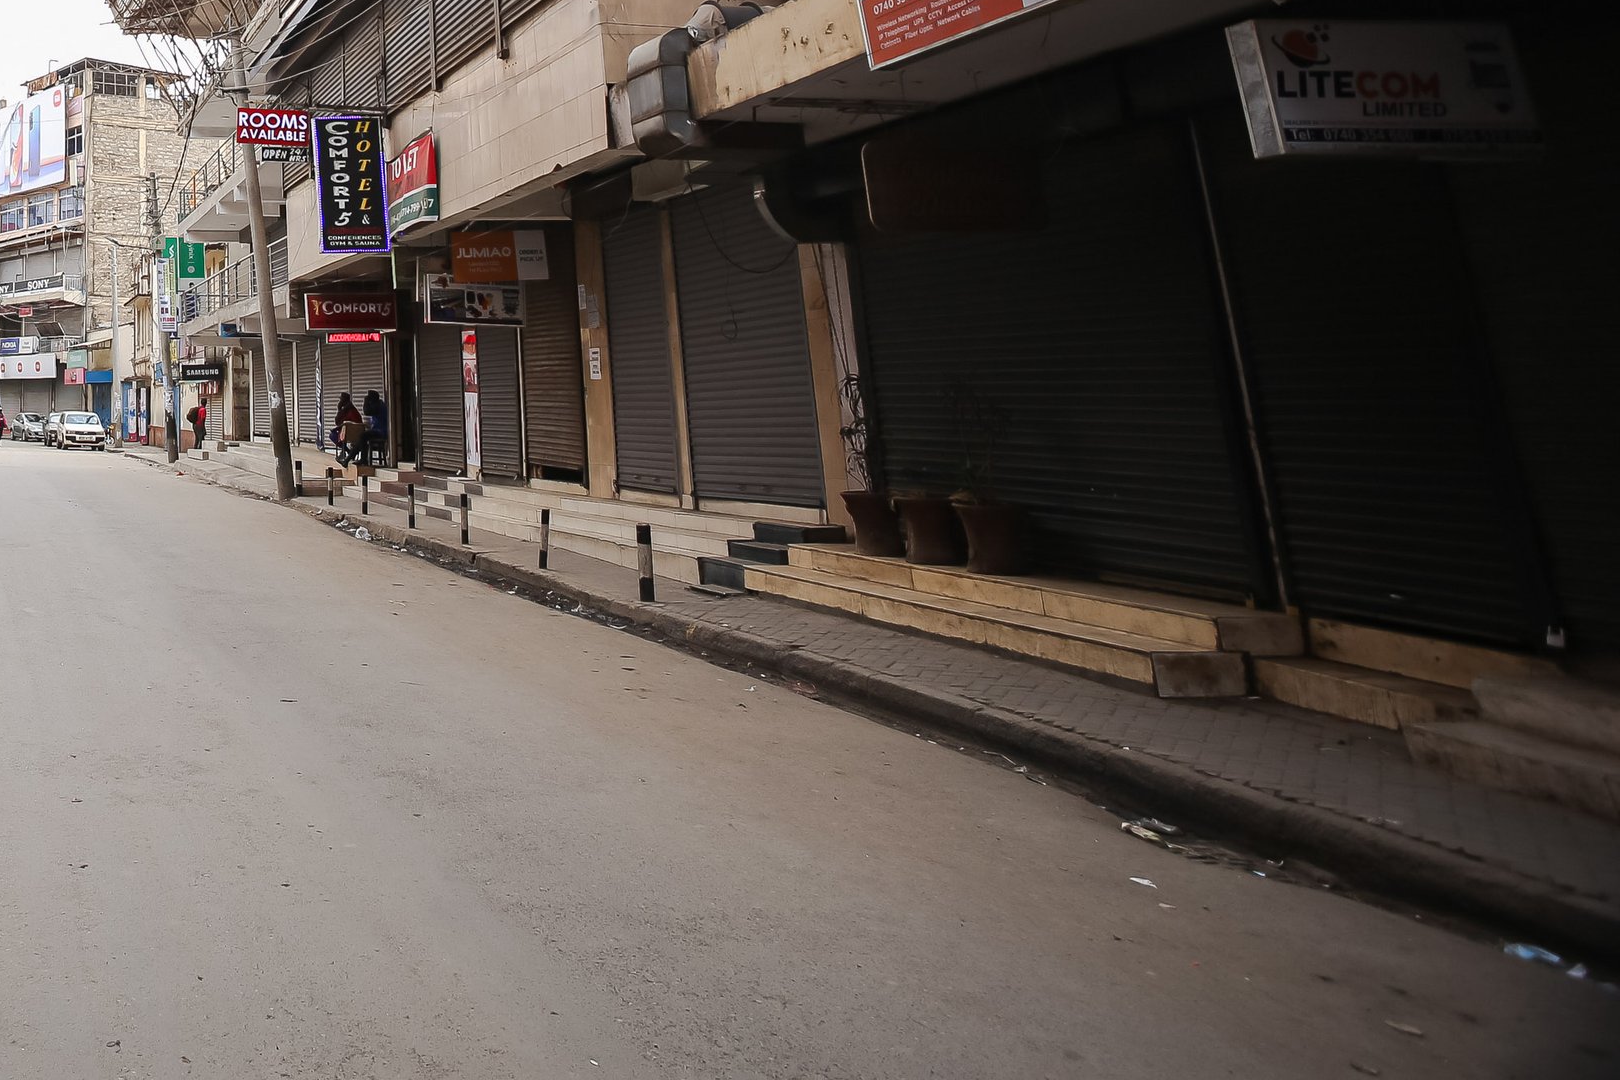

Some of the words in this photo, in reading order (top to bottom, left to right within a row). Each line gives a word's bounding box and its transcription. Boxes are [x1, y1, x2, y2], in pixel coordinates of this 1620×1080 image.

[884, 24, 910, 40] Telephony
[928, 9, 943, 20] CCTV
[947, 0, 966, 13] Access
[898, 6, 927, 22] Networking
[905, 30, 918, 40] Fiber
[937, 12, 960, 27] Network
[961, 4, 981, 17] Cables
[1277, 70, 1440, 98] LITECOM
[1362, 102, 1448, 118] LIMITED
[238, 111, 308, 130] ROOMS
[240, 129, 306, 142] AVAILABLE
[263, 149, 287, 159] OPEN
[391, 161, 401, 181] TO
[403, 146, 419, 175] LET
[325, 122, 350, 209] COMFORT
[354, 121, 372, 210] HOTEL
[362, 214, 370, 225] &
[27, 280, 50, 290] SONY
